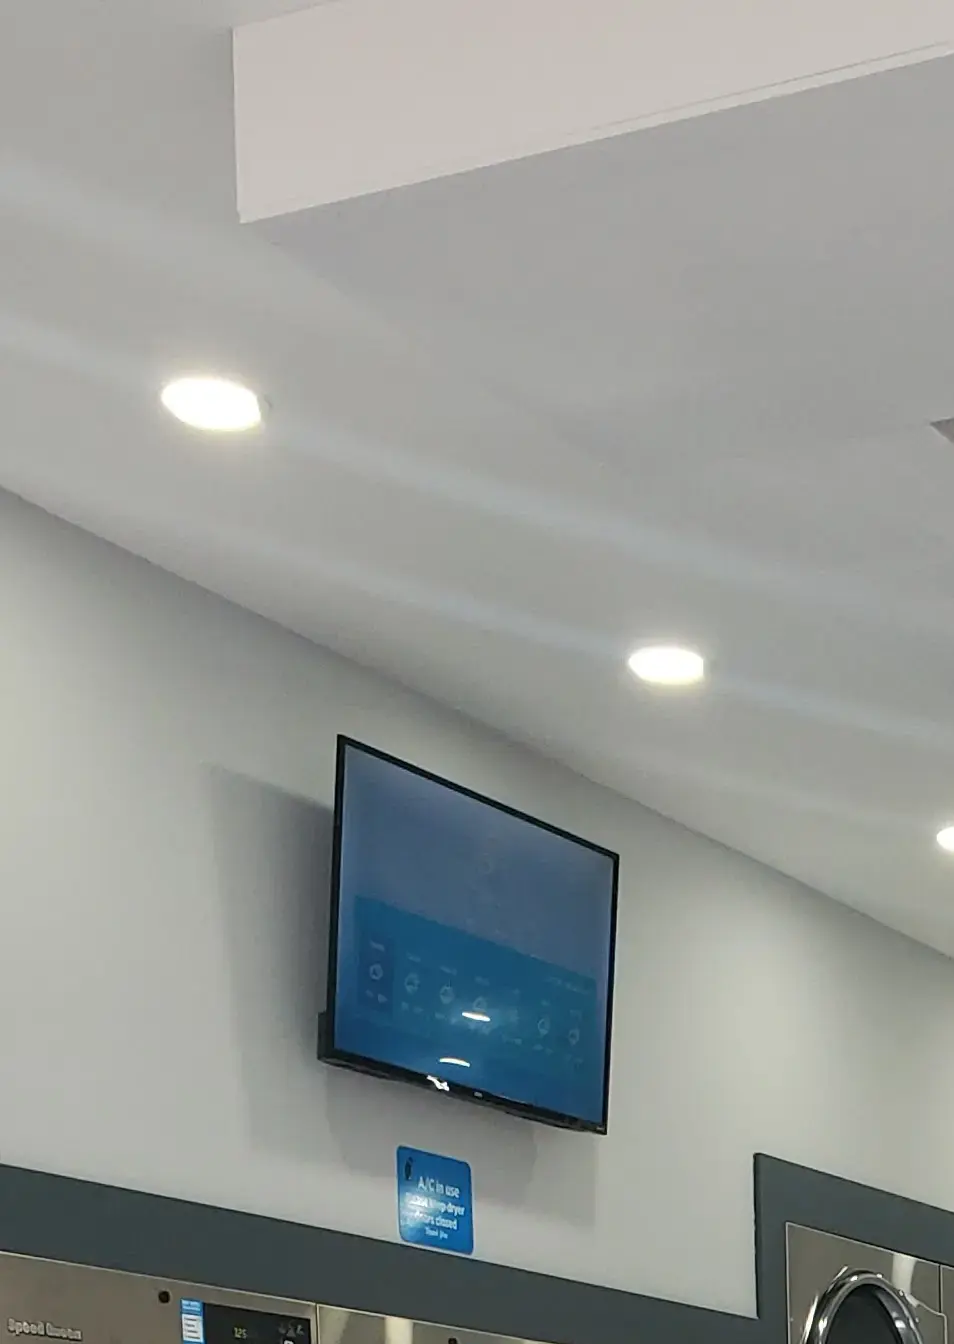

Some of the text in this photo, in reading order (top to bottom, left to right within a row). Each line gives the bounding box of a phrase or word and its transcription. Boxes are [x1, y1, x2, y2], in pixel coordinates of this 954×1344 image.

[417, 1176, 434, 1192] A/C
[445, 1185, 460, 1198] use
[435, 1216, 457, 1230] closed
[8, 1318, 44, 1335] Speed
